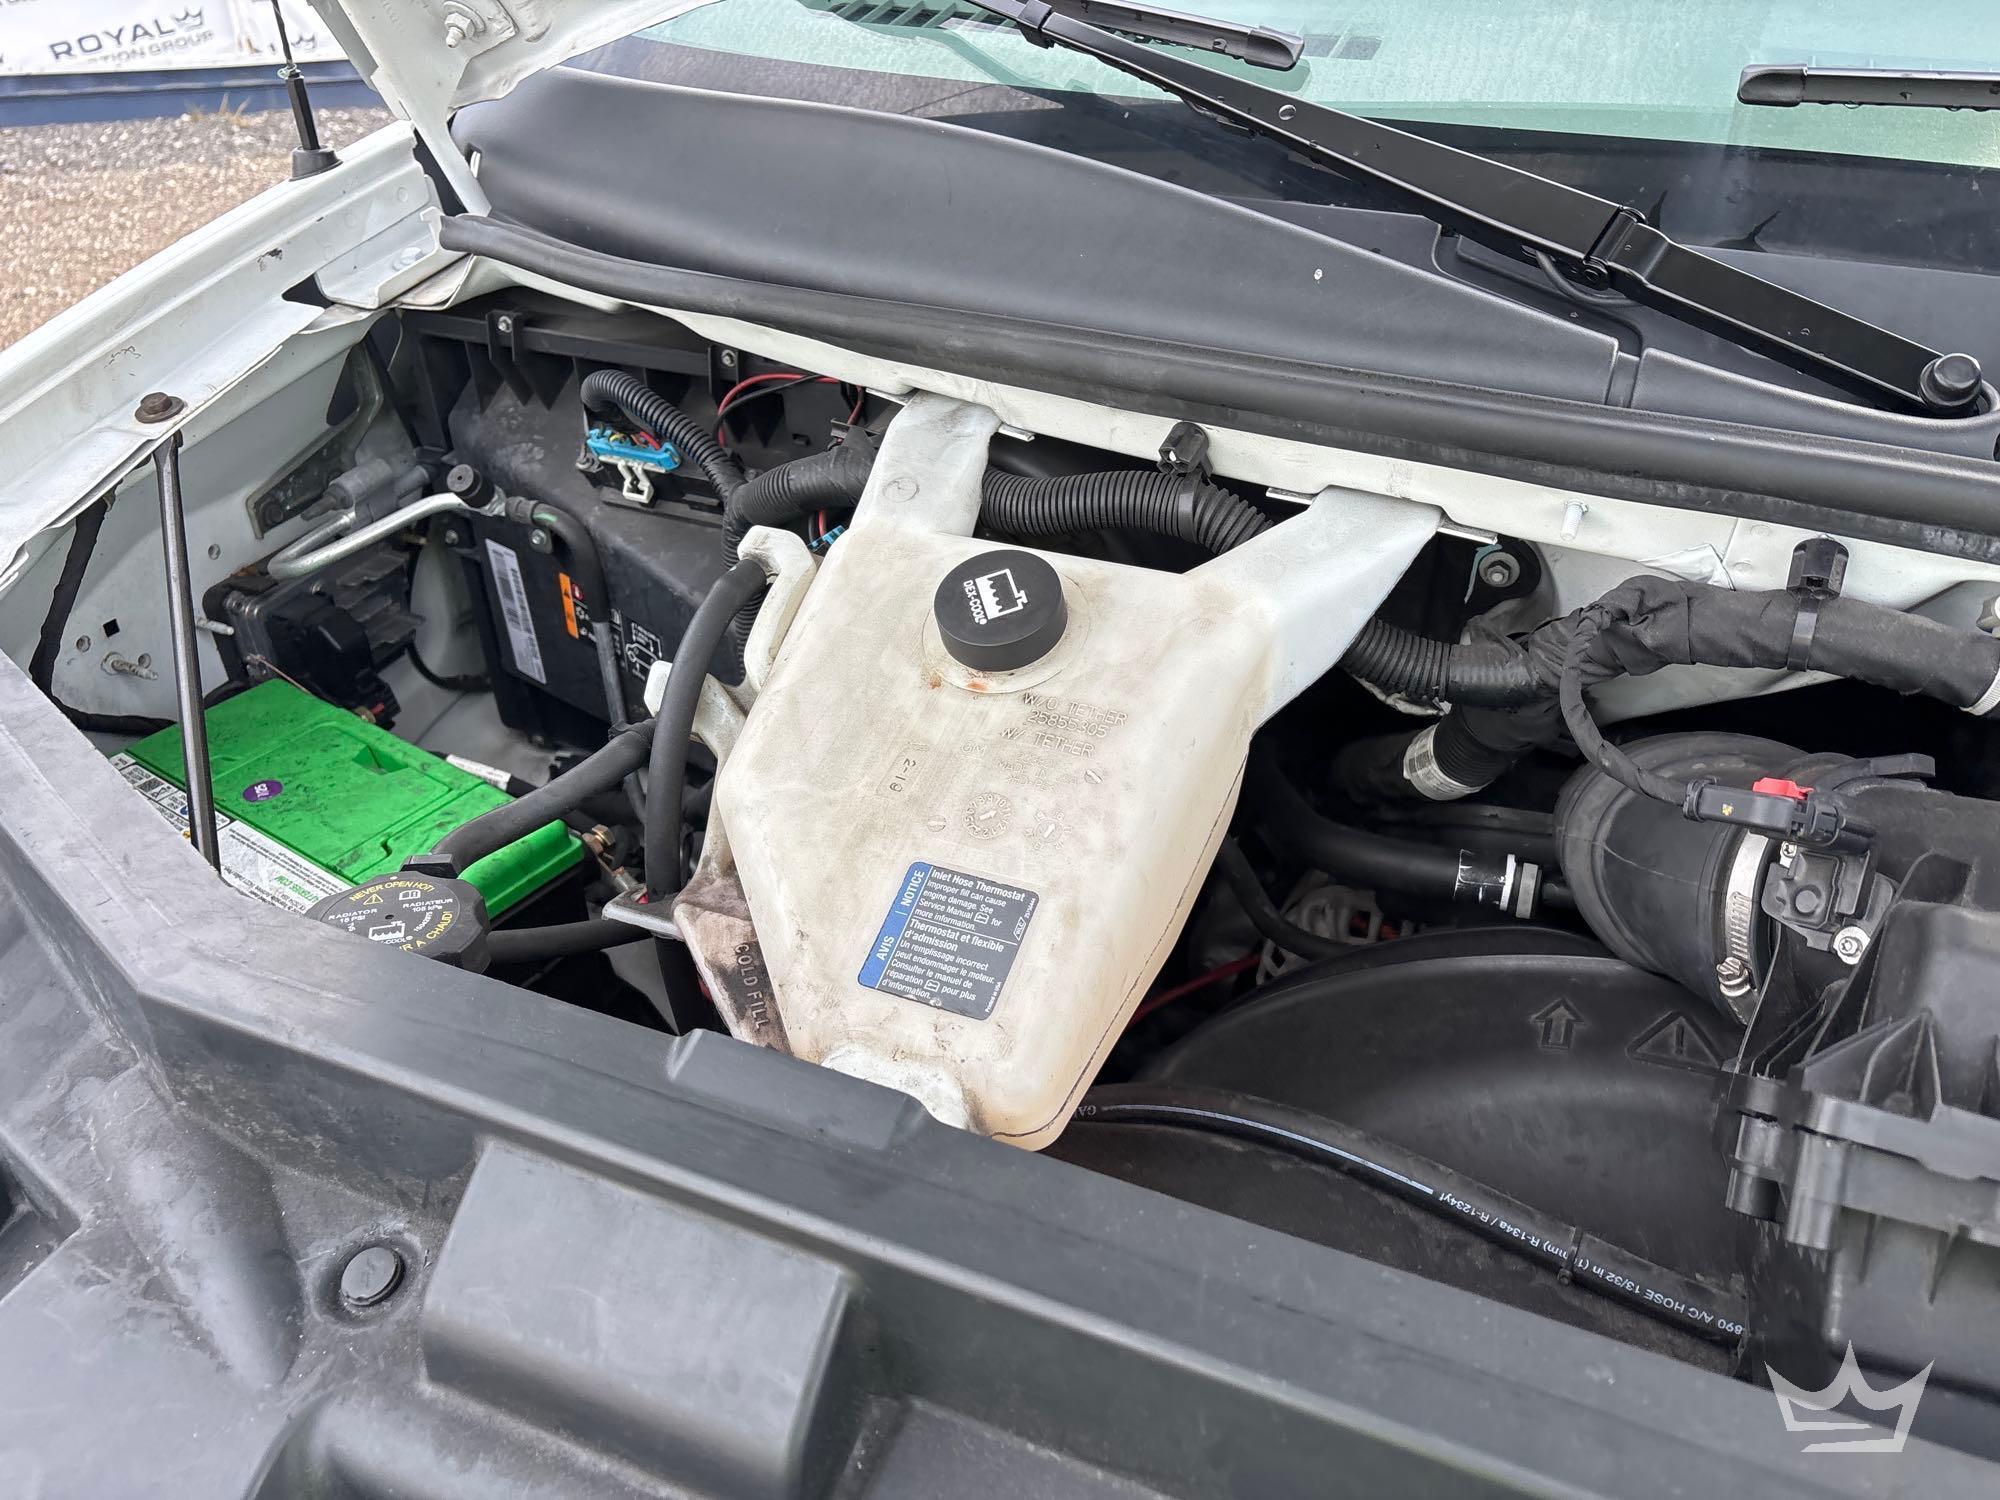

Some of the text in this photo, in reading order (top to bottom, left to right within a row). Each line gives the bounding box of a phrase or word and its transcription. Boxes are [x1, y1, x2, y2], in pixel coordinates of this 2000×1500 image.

[49, 19, 175, 60] ROYAL
[1024, 692, 1128, 726] W/O TETHER
[1033, 732, 1095, 758] TETHER
[349, 884, 384, 902] NEVER
[385, 880, 414, 889] OPEN
[900, 870, 924, 906] NOTICE
[926, 880, 1006, 907] Improper fill can cause
[932, 870, 1026, 902] Inlet Hose Thermostat
[328, 908, 378, 920] RADIATOR
[402, 898, 453, 908] RADIATEUR
[918, 899, 1002, 927] Service Manual for
[923, 890, 994, 914] engine damage. See
[914, 908, 976, 932] more information.
[876, 936, 895, 960] AVIS
[904, 930, 958, 952] d'admission
[910, 918, 1004, 952] Thermostat et flexible
[895, 950, 994, 984] peut endommager le moteur.
[900, 940, 988, 972] Un remplissage incorrect
[734, 942, 770, 1030] COLD FILL
[891, 959, 973, 989] Consulter le manuel de
[882, 978, 932, 1000] d'information.
[941, 986, 959, 996] pour
[960, 989, 976, 1001] plus
[1439, 1192, 1490, 1223] R-1234yf
[1499, 1220, 1541, 1248] R-134a
[1592, 1264, 1604, 1278] in
[1605, 1271, 1640, 1294] 13/32
[1643, 1288, 1686, 1314] HOSE
[1688, 1306, 1714, 1324] A/C
[1718, 1318, 1744, 1335] 890
